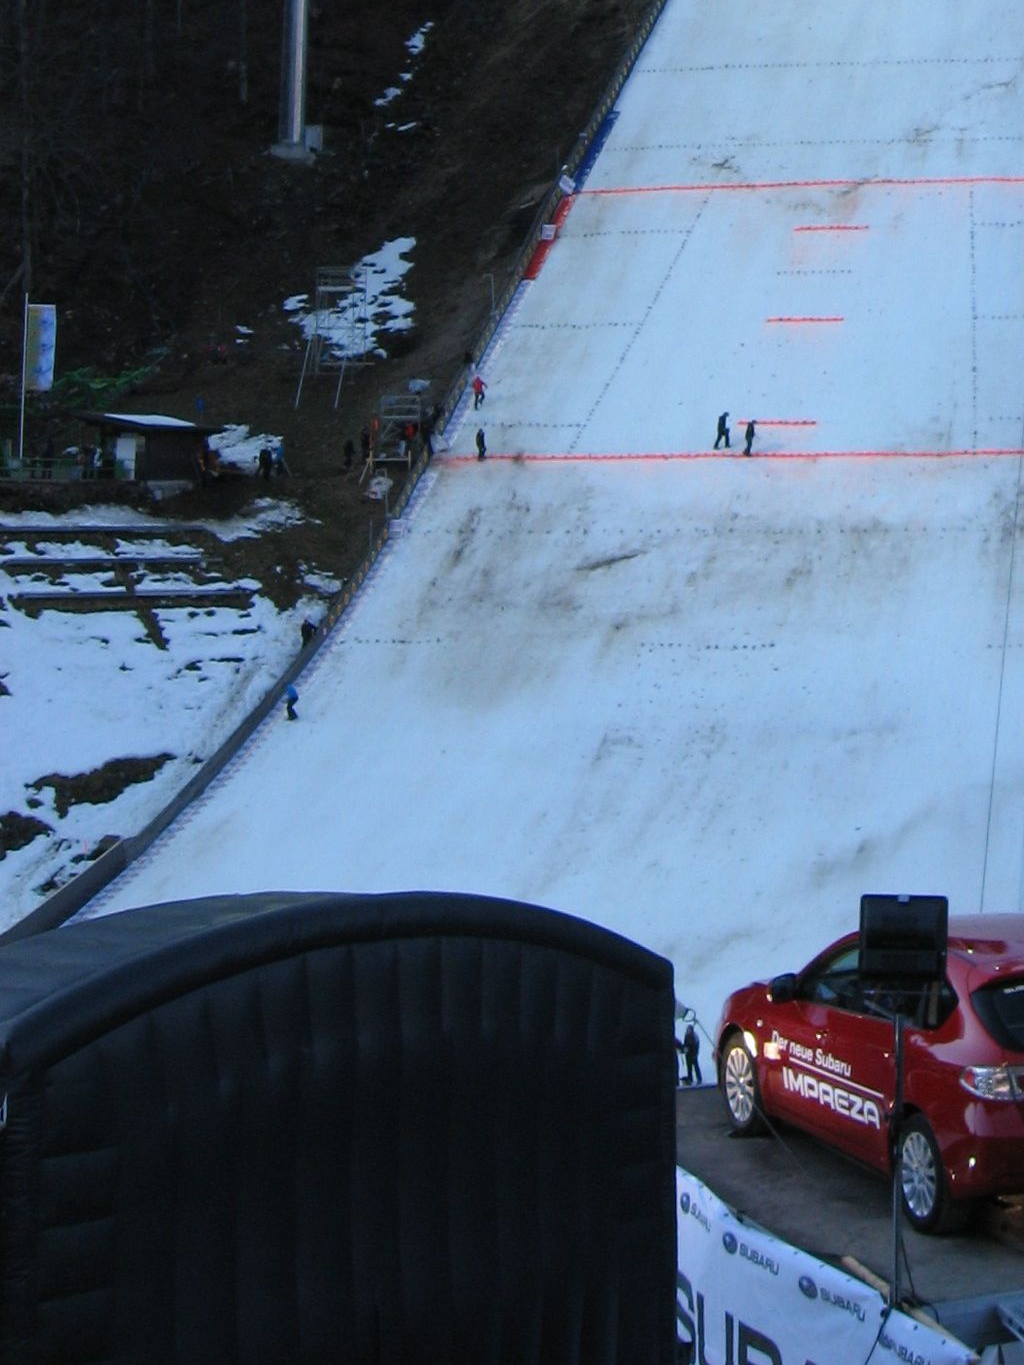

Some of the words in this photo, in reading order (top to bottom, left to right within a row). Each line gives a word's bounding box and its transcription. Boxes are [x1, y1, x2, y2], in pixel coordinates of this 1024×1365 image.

[771, 1030, 789, 1050] Der
[789, 1041, 814, 1062] neue
[815, 1048, 852, 1077] Subaru
[782, 1065, 881, 1130] IMPREZA
[739, 1244, 780, 1277] SUBARU
[819, 1286, 867, 1323] SUBARU
